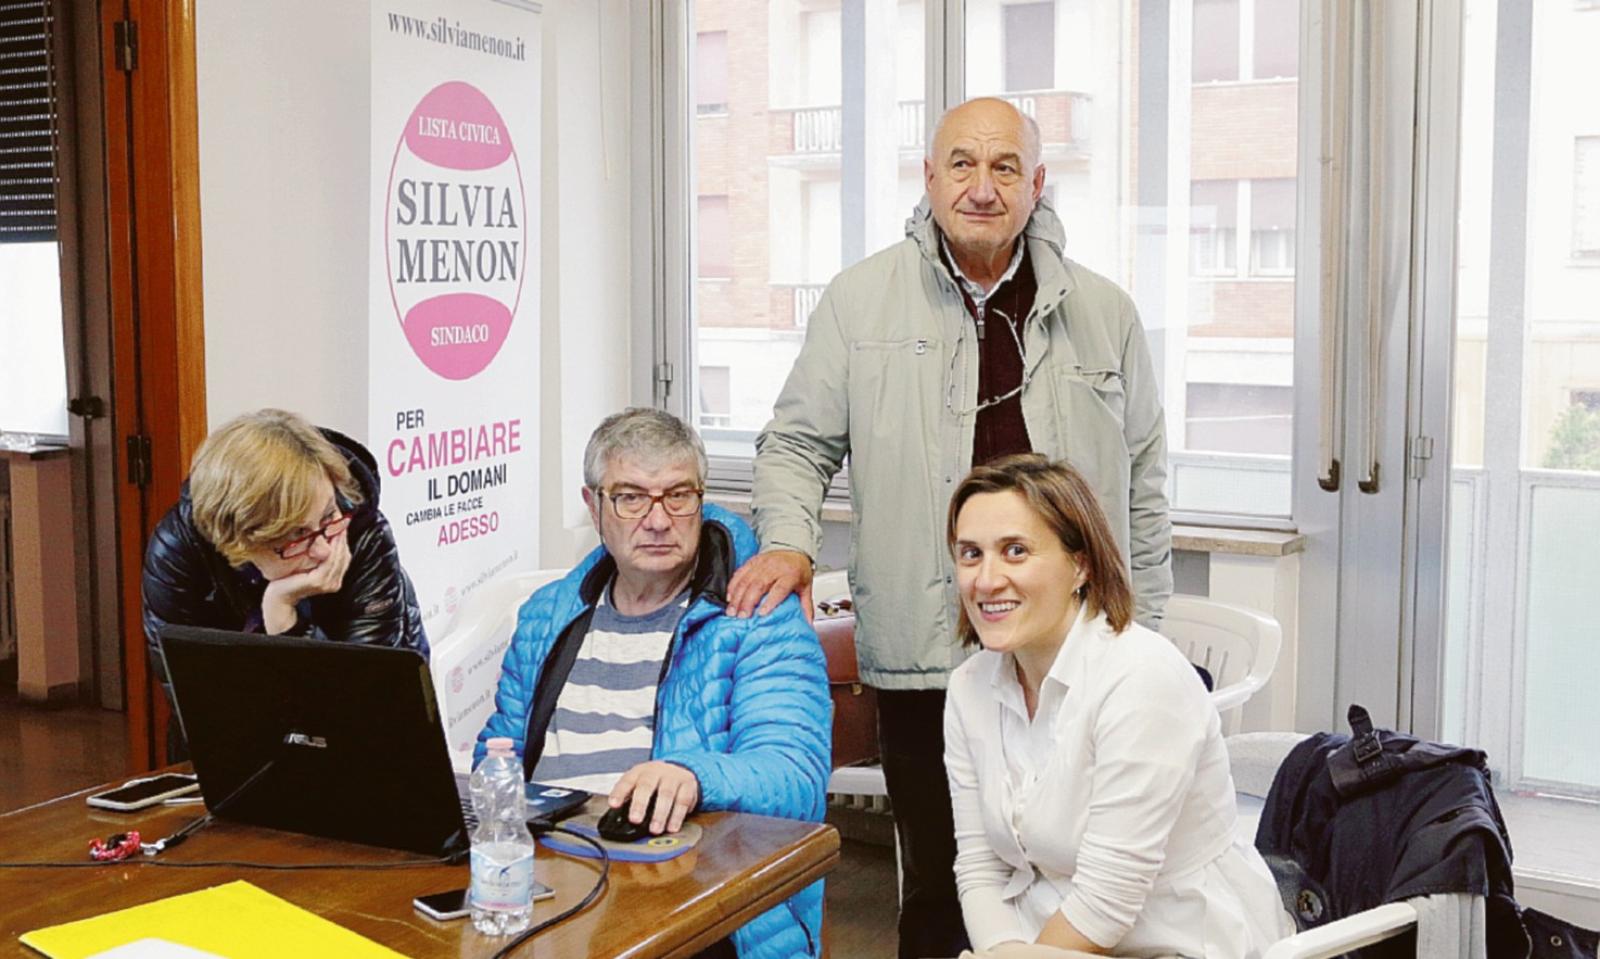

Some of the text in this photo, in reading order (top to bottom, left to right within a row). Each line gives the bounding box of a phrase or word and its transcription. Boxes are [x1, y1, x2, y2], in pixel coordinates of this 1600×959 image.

[387, 12, 526, 61] www.silviamenon.it
[418, 116, 500, 145] LISTA CIVICA
[396, 178, 518, 228] SILVIA
[396, 238, 519, 283] MENON
[431, 324, 489, 346] SINDACO
[396, 408, 425, 431] PER
[387, 419, 522, 477] CAMBIARE
[428, 463, 507, 501] IL DOMANI
[406, 496, 484, 526] CAMBIA LE FACCE
[437, 511, 499, 547] ADESSO
